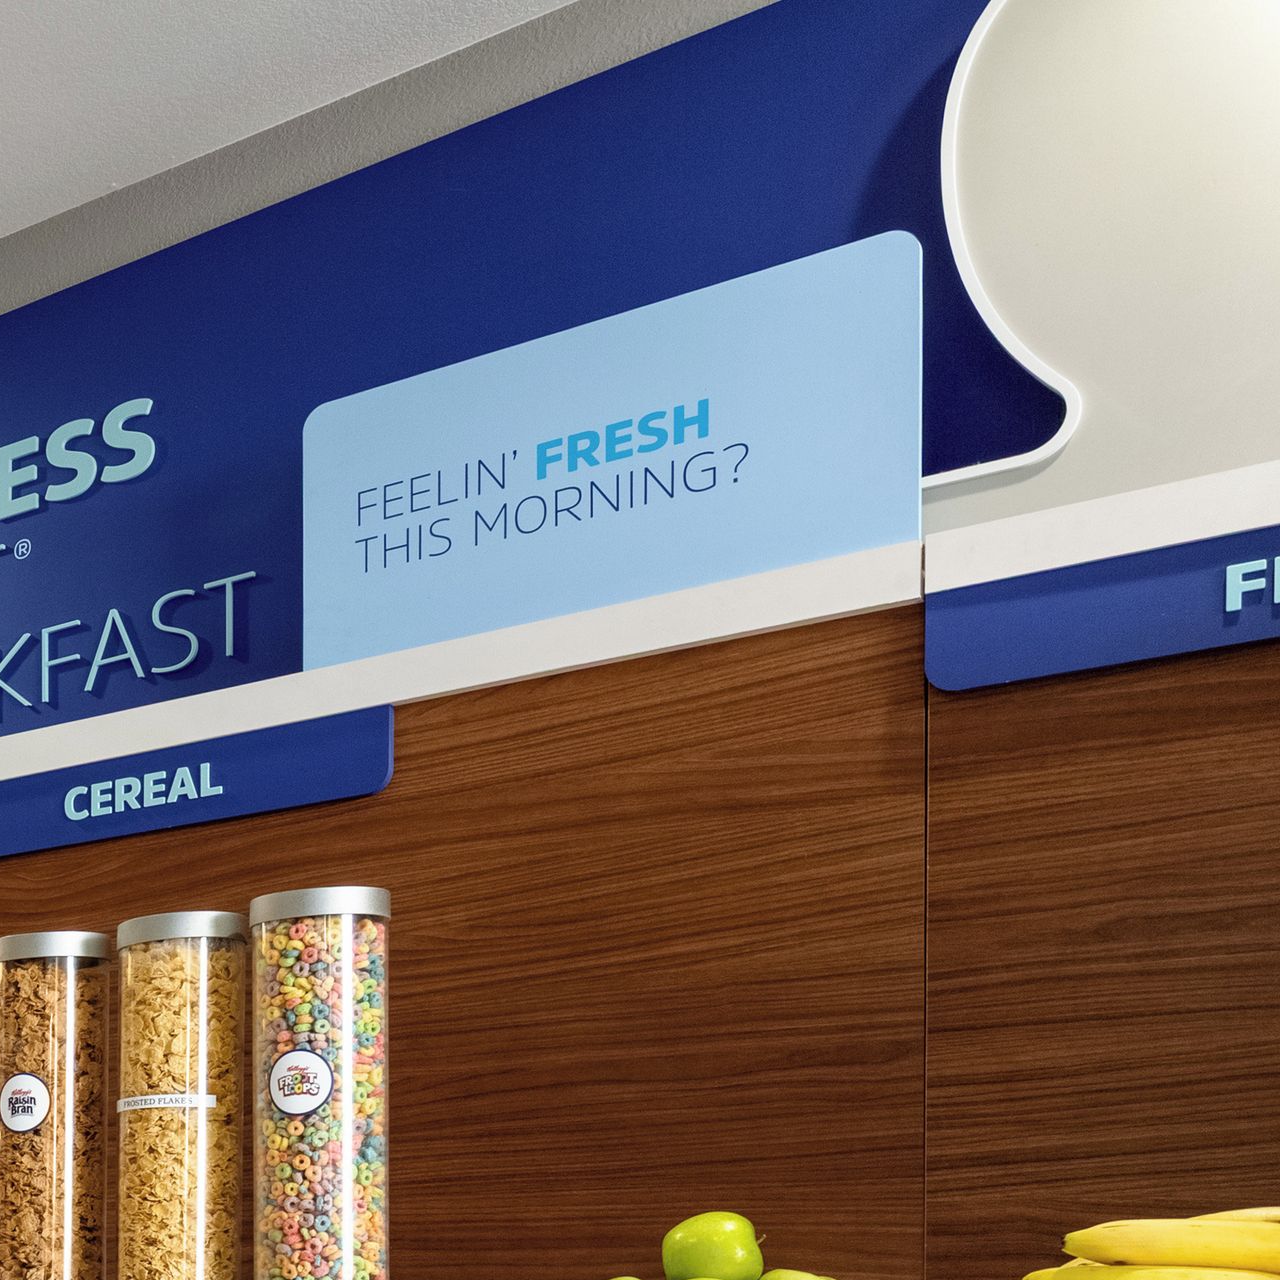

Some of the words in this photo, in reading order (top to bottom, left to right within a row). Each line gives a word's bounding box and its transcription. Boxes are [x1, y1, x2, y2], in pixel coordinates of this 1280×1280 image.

[536, 398, 710, 481] FRESH
[355, 517, 452, 574] THIS
[474, 443, 750, 546] MORNING?
[64, 762, 223, 821] CEREAL
[283, 1082, 320, 1097] LOOPS
[8, 1096, 36, 1107] Raisin
[123, 1098, 156, 1108] FROSTED
[158, 1096, 193, 1105] FLAKES
[11, 1105, 33, 1115] Bran
